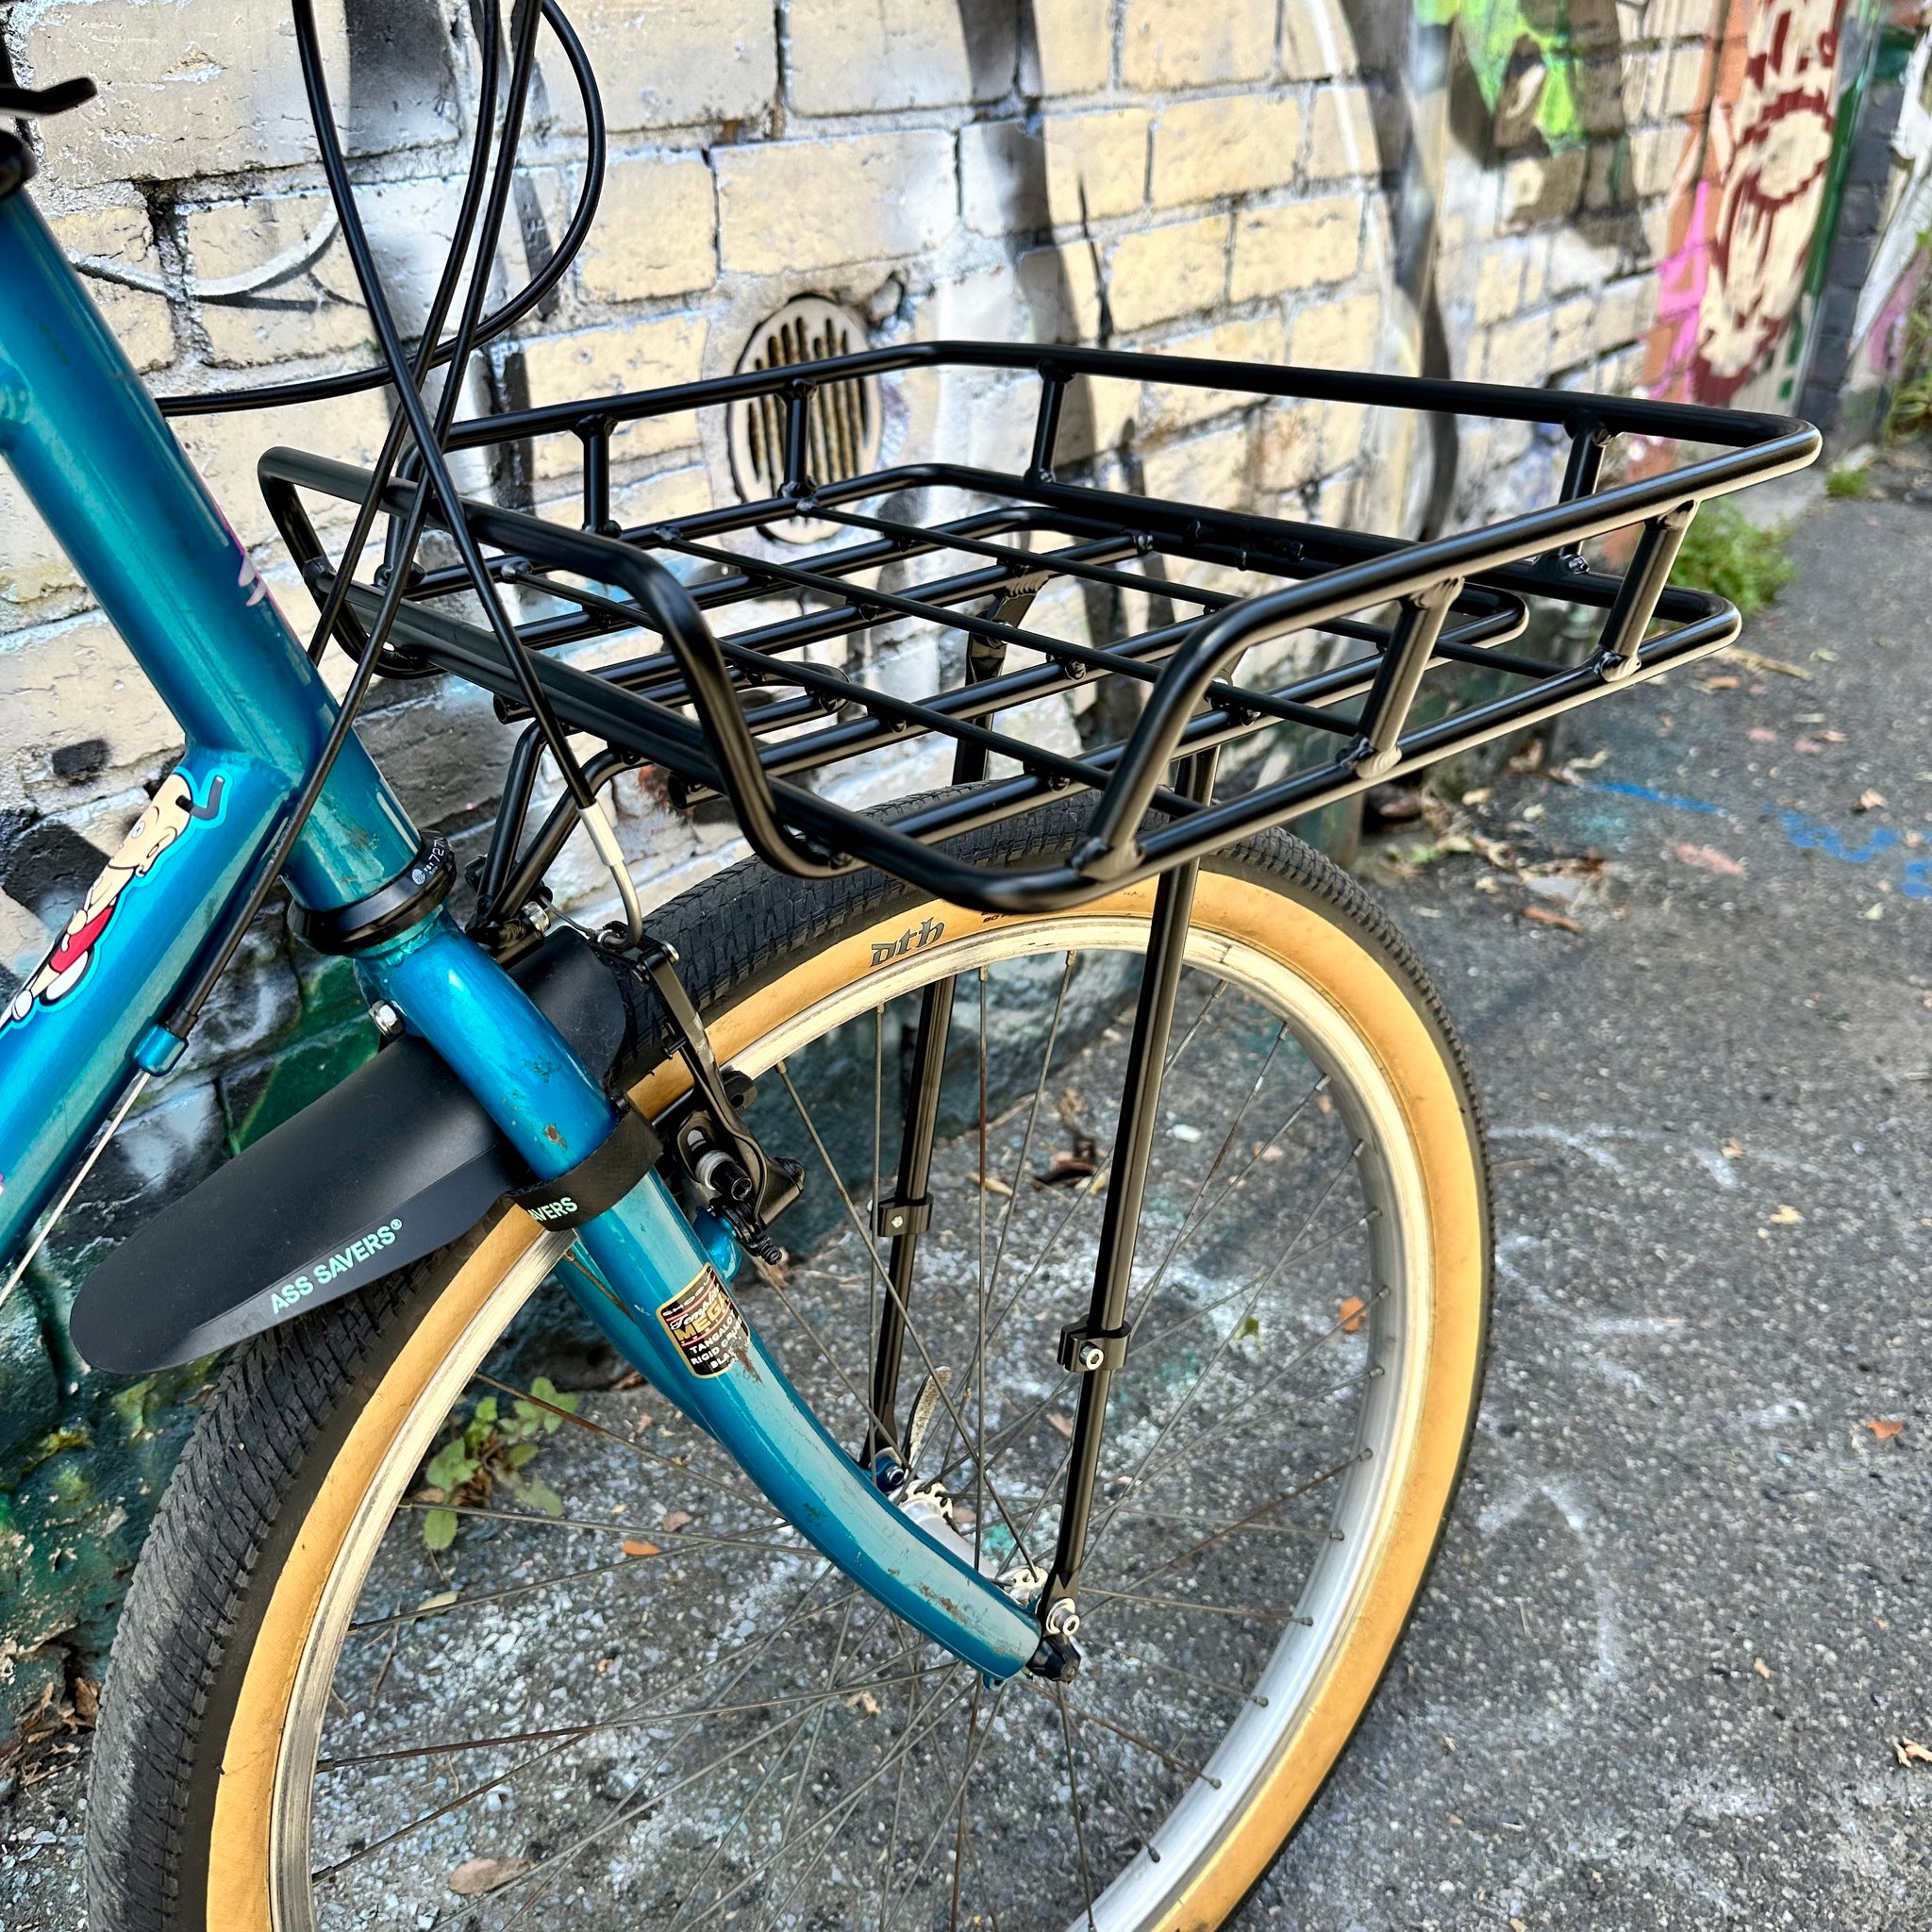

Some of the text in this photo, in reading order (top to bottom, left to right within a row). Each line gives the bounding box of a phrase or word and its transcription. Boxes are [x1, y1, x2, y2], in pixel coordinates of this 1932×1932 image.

[271, 1275, 314, 1314] ASS
[674, 1291, 729, 1341] MEGA
[690, 1309, 735, 1354] TANGALOY
[690, 1346, 720, 1365] RIGID
